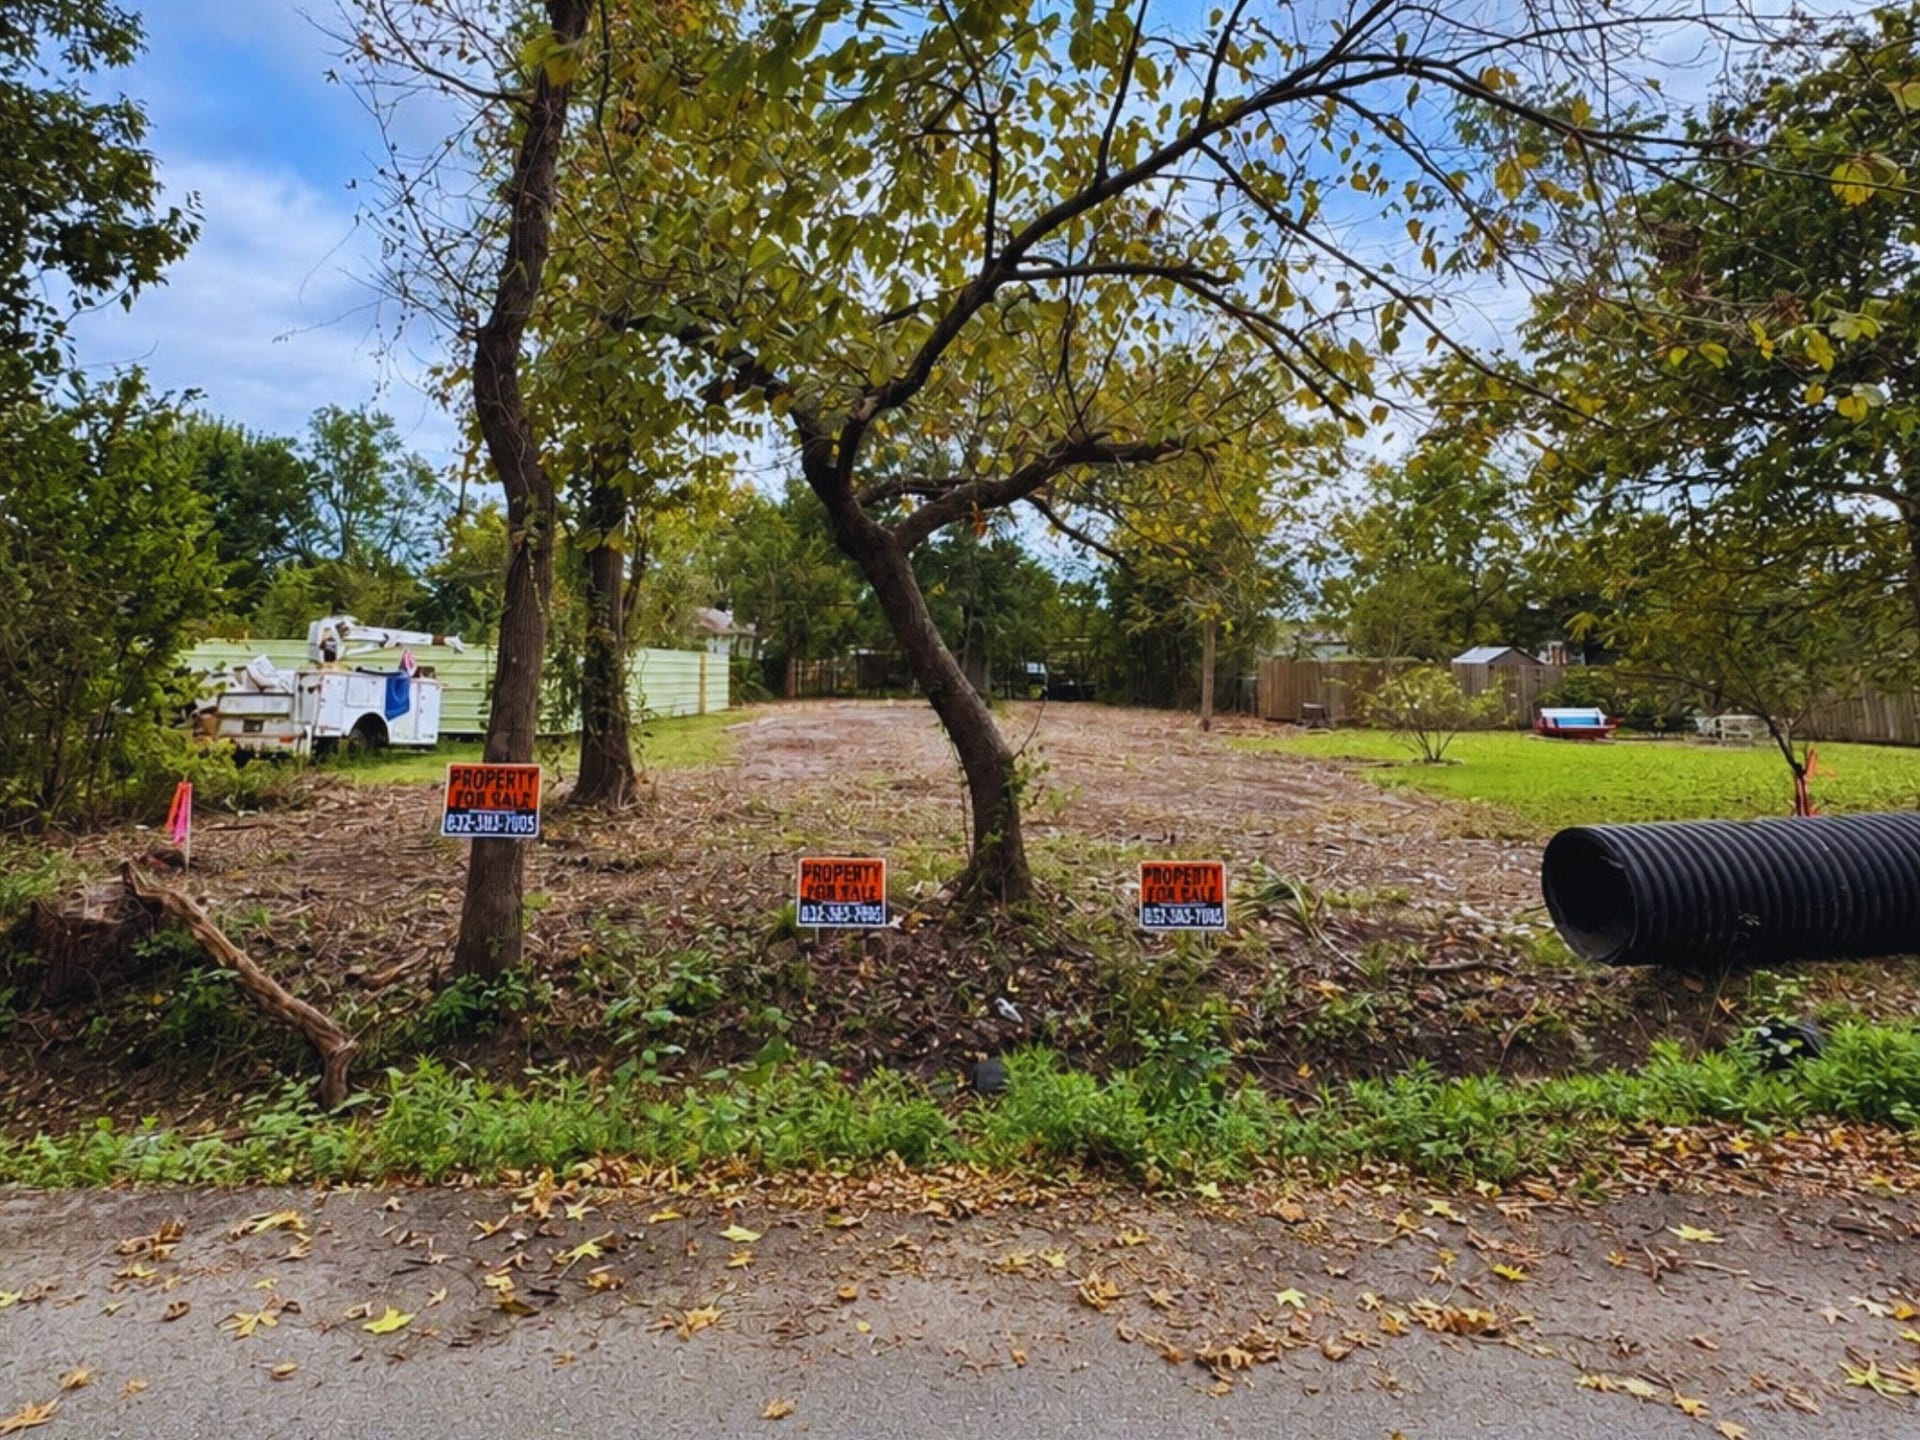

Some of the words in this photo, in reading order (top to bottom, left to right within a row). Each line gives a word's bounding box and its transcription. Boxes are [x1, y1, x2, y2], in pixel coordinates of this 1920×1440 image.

[450, 769, 537, 790] PROPERTY
[456, 791, 485, 806] FOR
[492, 791, 531, 807] SALE
[802, 863, 880, 883] PROPERTY
[1143, 867, 1218, 885] PROPERTY
[807, 884, 835, 900] FOR
[841, 884, 877, 901] SALE
[1147, 886, 1175, 901] FOR
[1181, 886, 1216, 902] SALE
